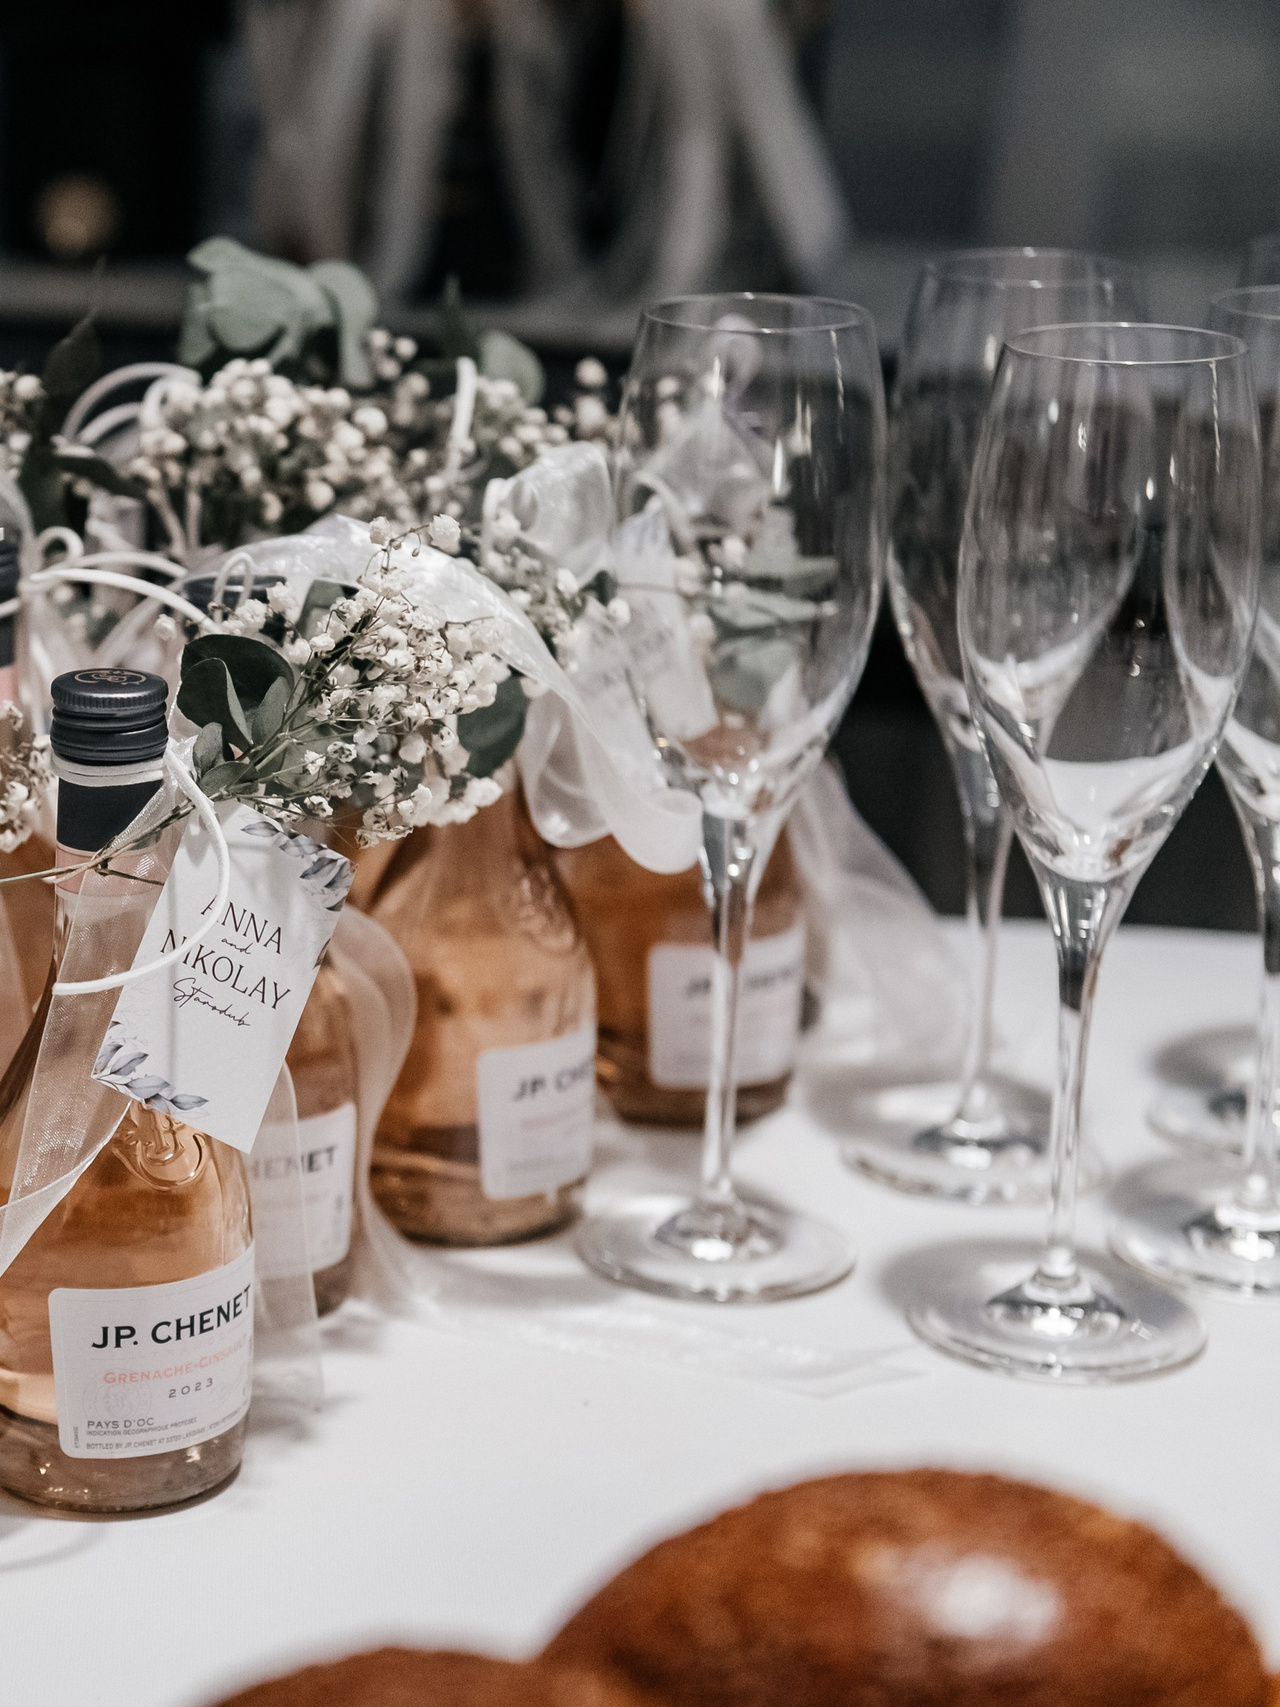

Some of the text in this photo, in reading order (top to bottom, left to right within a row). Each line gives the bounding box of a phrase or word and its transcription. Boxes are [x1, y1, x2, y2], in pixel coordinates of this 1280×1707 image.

[221, 938, 253, 955] and
[91, 1283, 251, 1349] JP. CHENET
[168, 1377, 214, 1399] 2023
[87, 1417, 154, 1429] PAYS D'OC
[133, 1438, 157, 1448] CHENET
